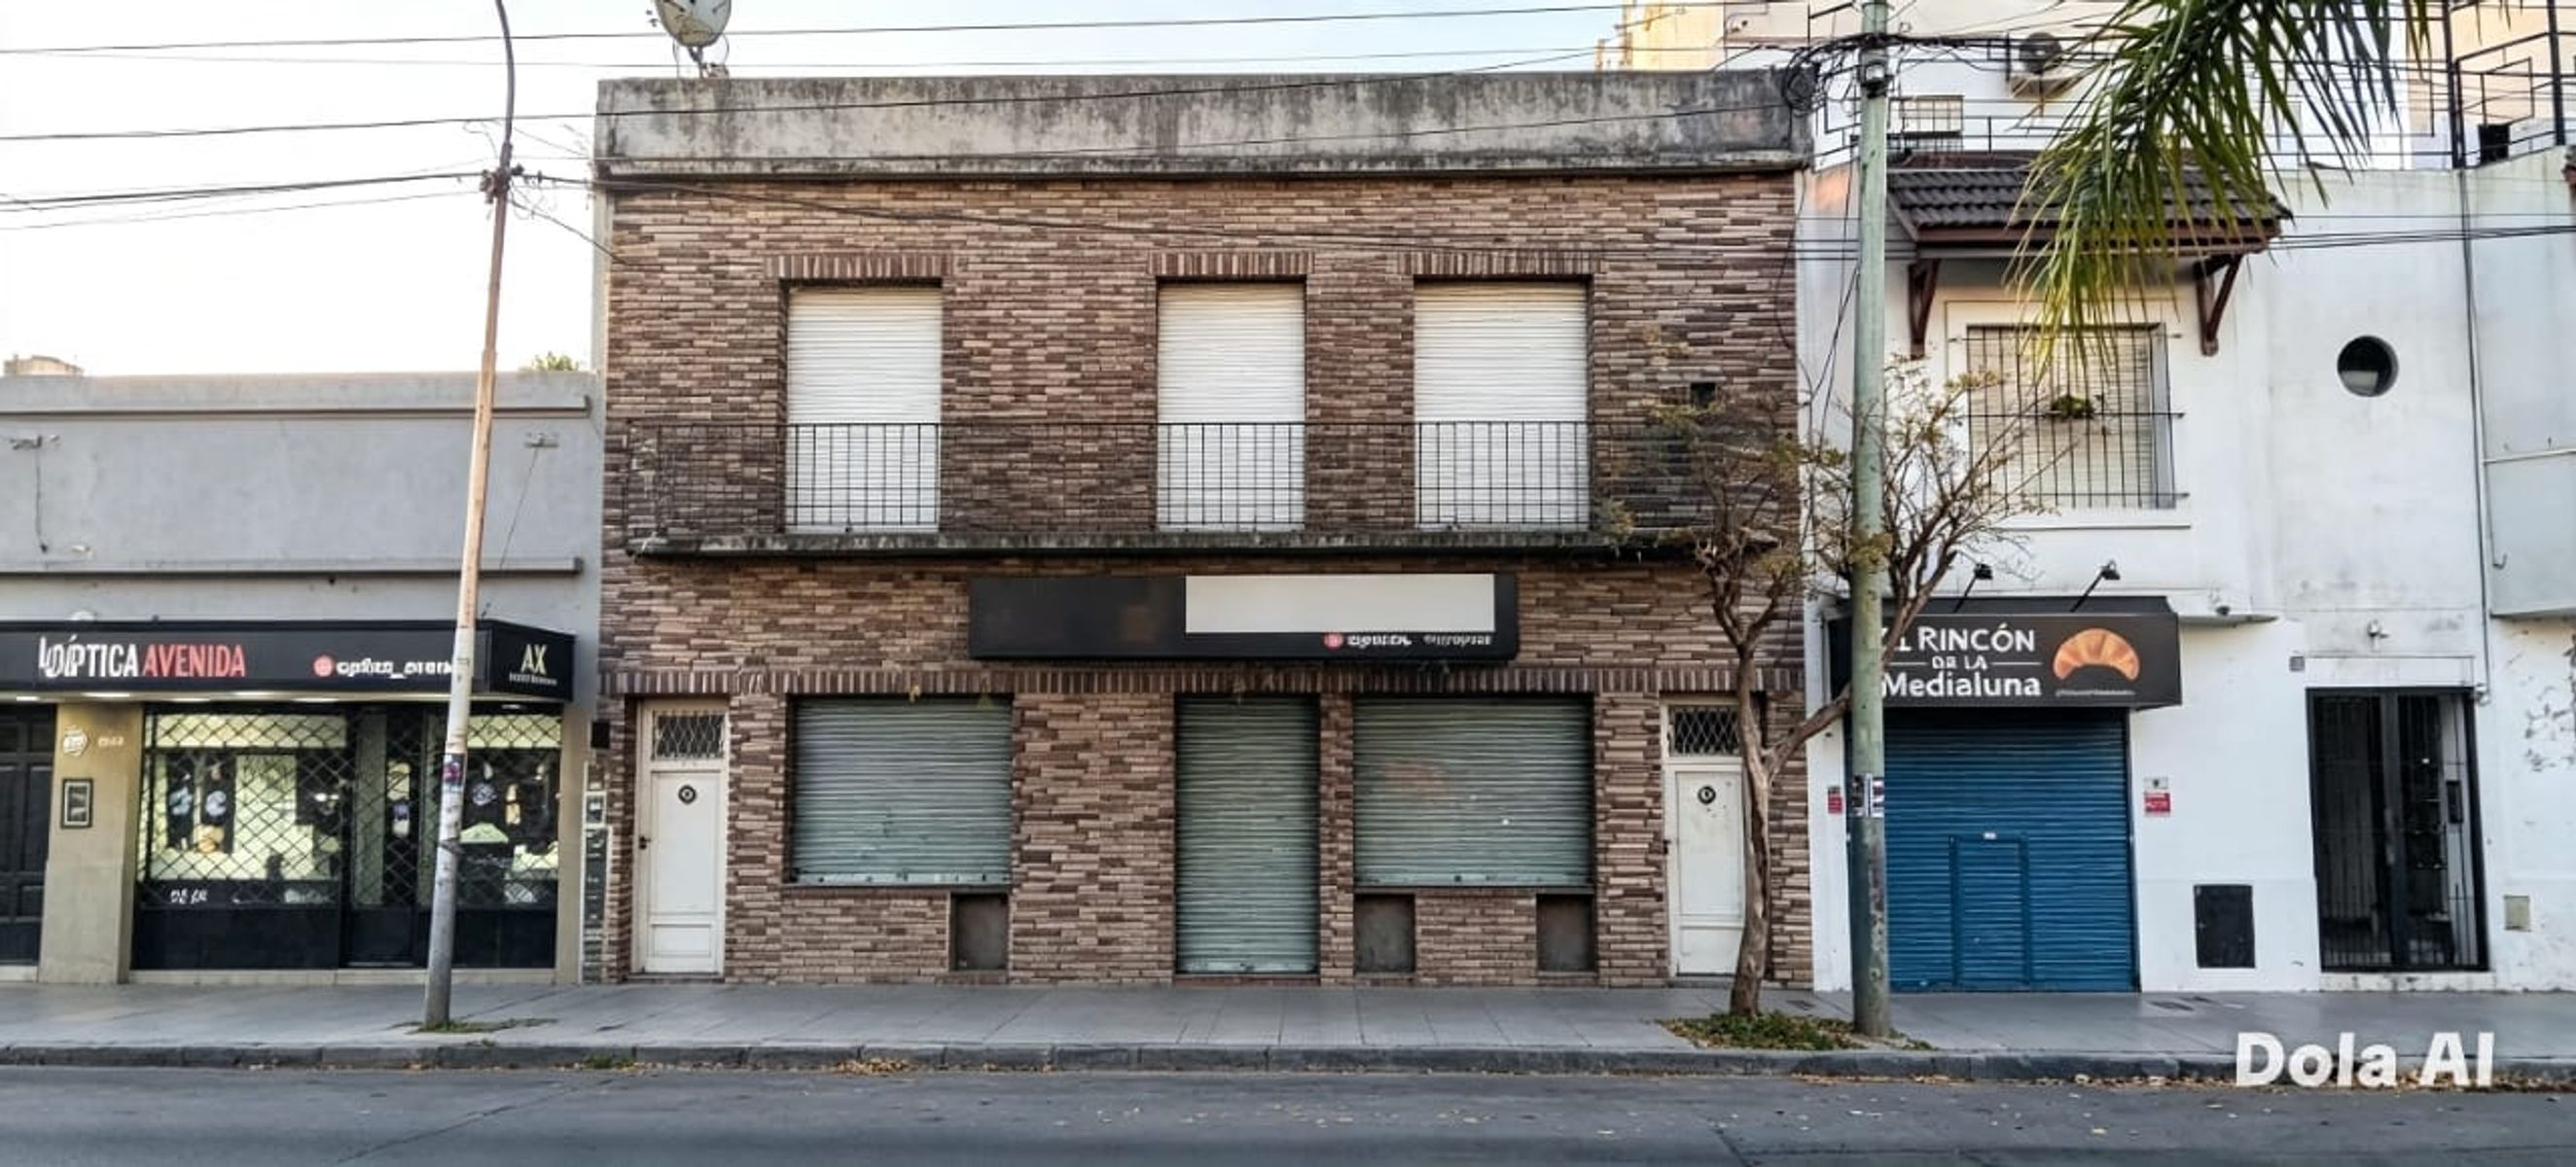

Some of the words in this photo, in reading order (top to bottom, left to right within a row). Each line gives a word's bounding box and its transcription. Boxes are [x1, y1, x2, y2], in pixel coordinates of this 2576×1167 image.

[1917, 622, 2036, 653] RINCÓN
[142, 643, 246, 679] AVENIDA
[520, 643, 548, 675] AX
[1963, 654, 1988, 671] LA
[1881, 670, 2042, 698] Medialuna
